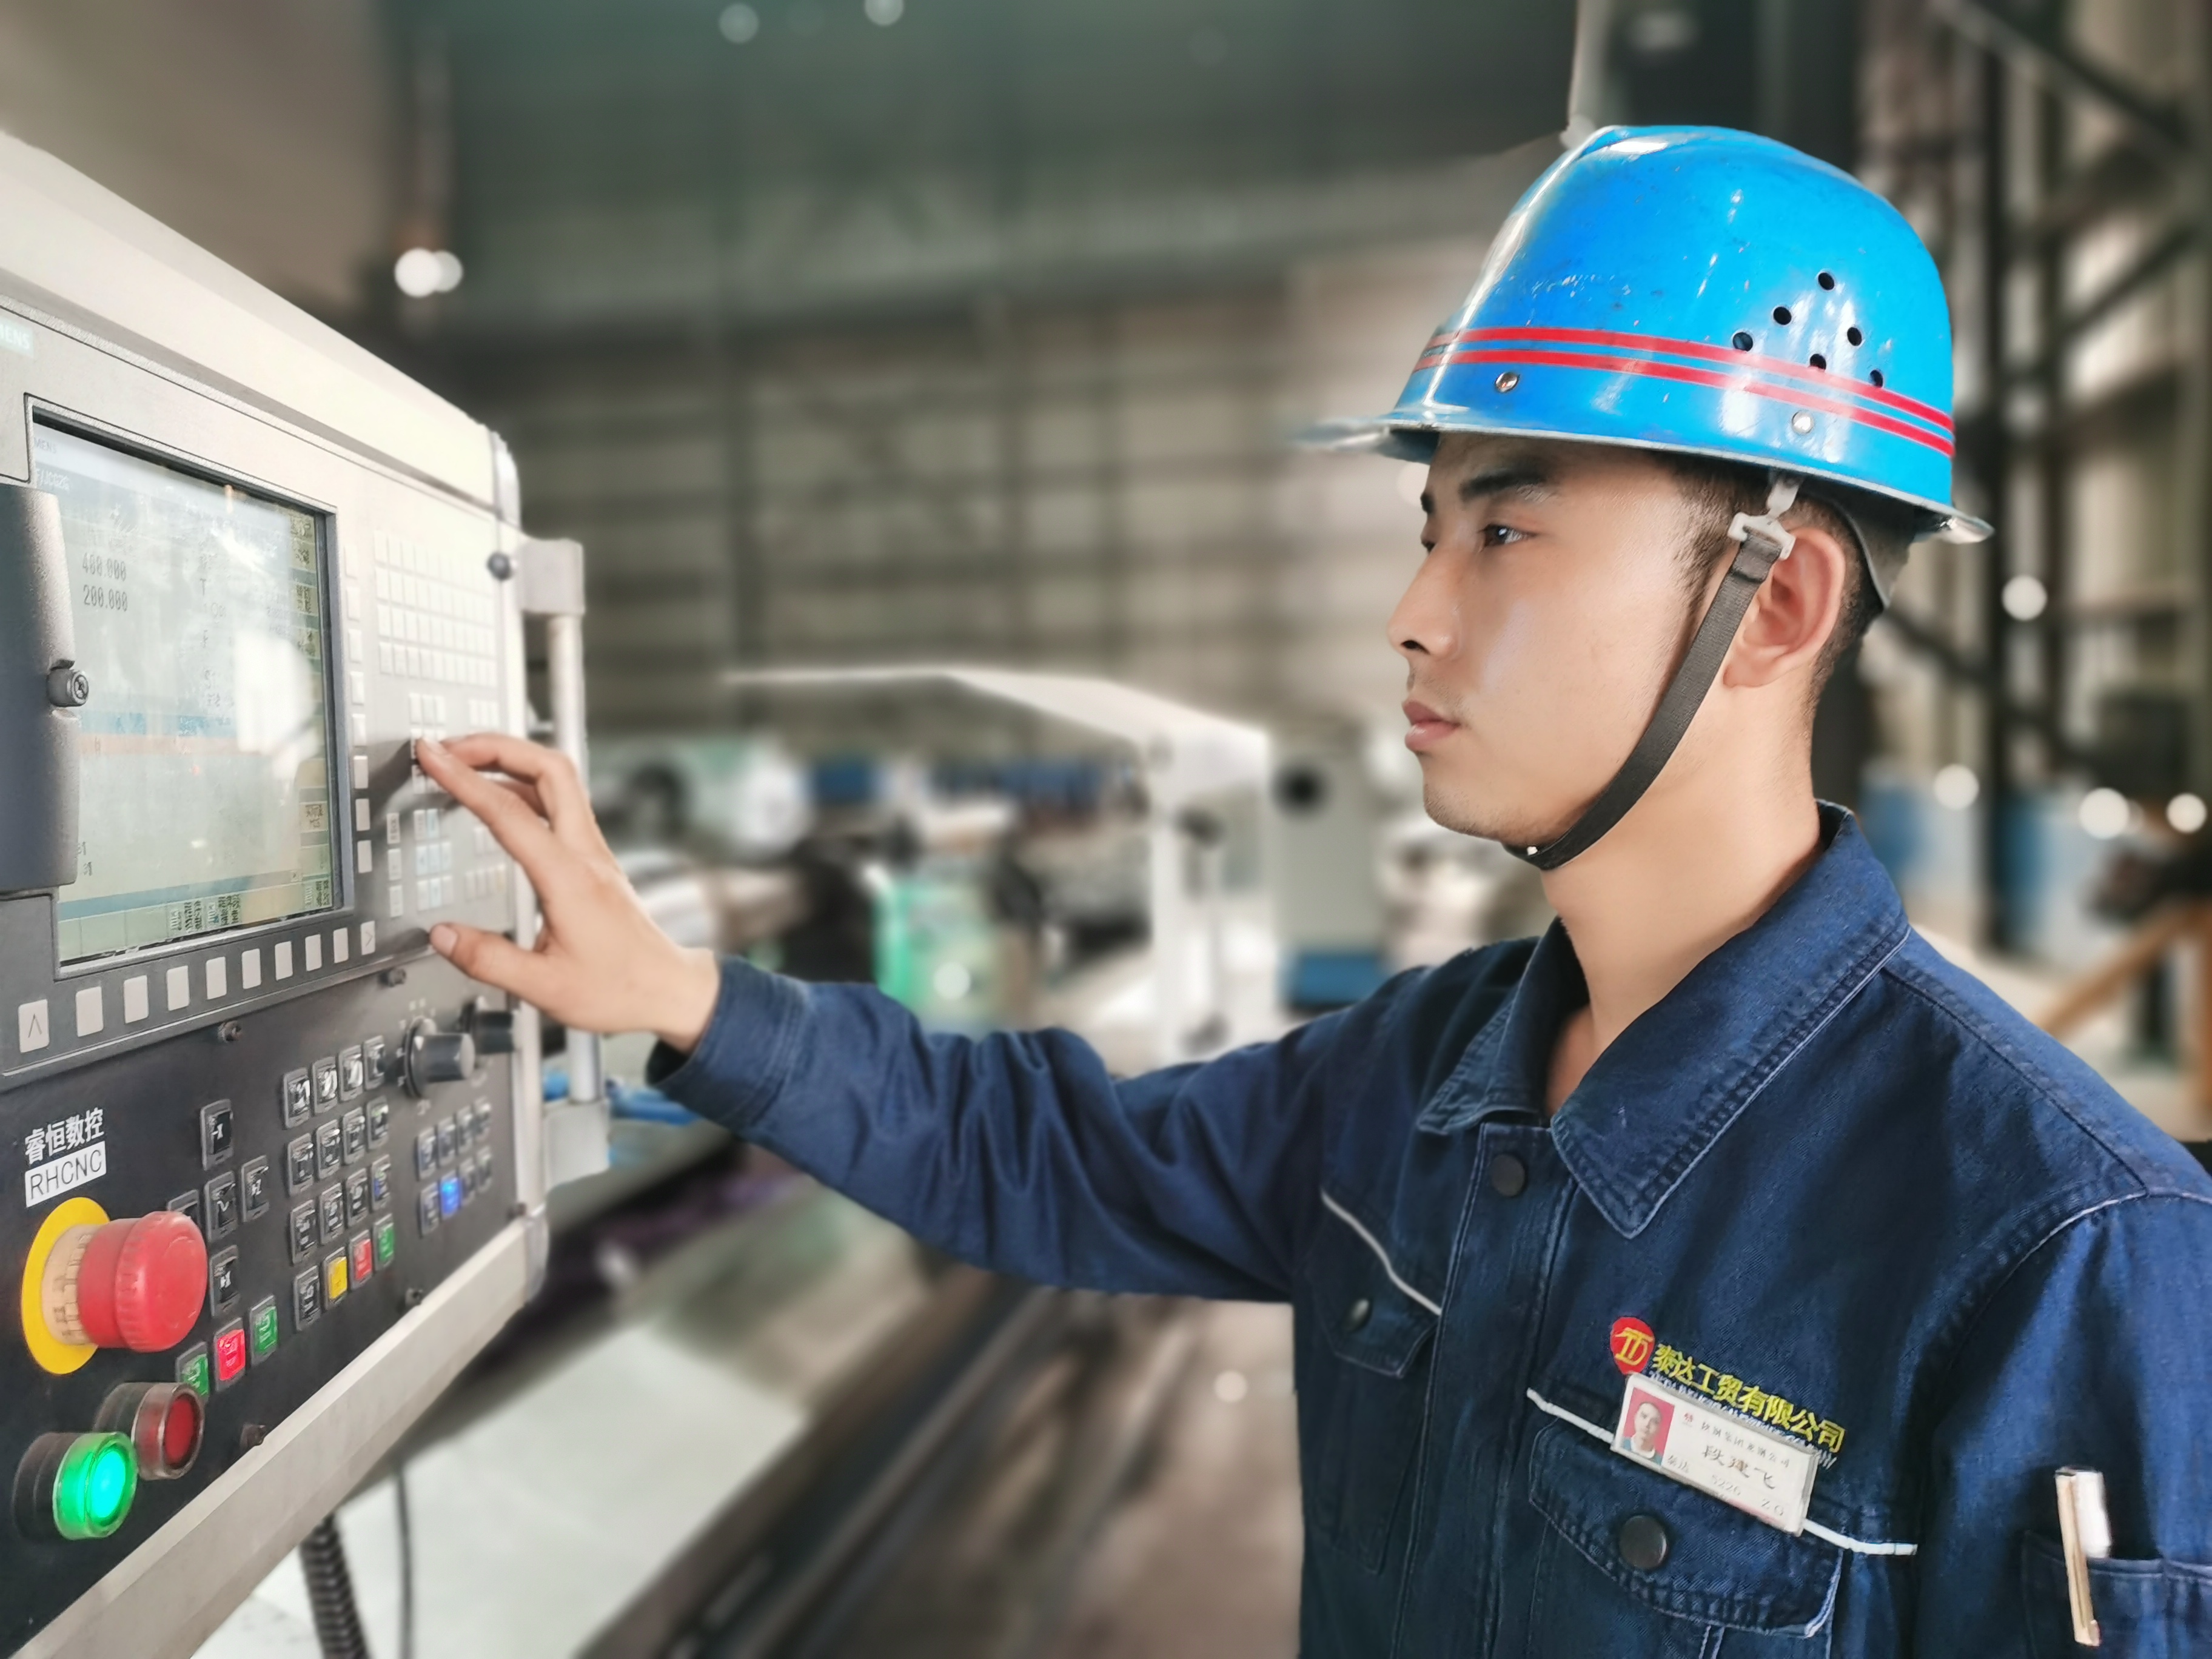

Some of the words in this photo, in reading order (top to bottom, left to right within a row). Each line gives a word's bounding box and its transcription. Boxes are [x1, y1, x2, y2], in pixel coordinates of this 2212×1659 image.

[25, 1107, 104, 1164] 睿恒数控
[30, 1150, 102, 1199] RHCNC
[1651, 1343, 1846, 1453] 泰达工贸有限公司
